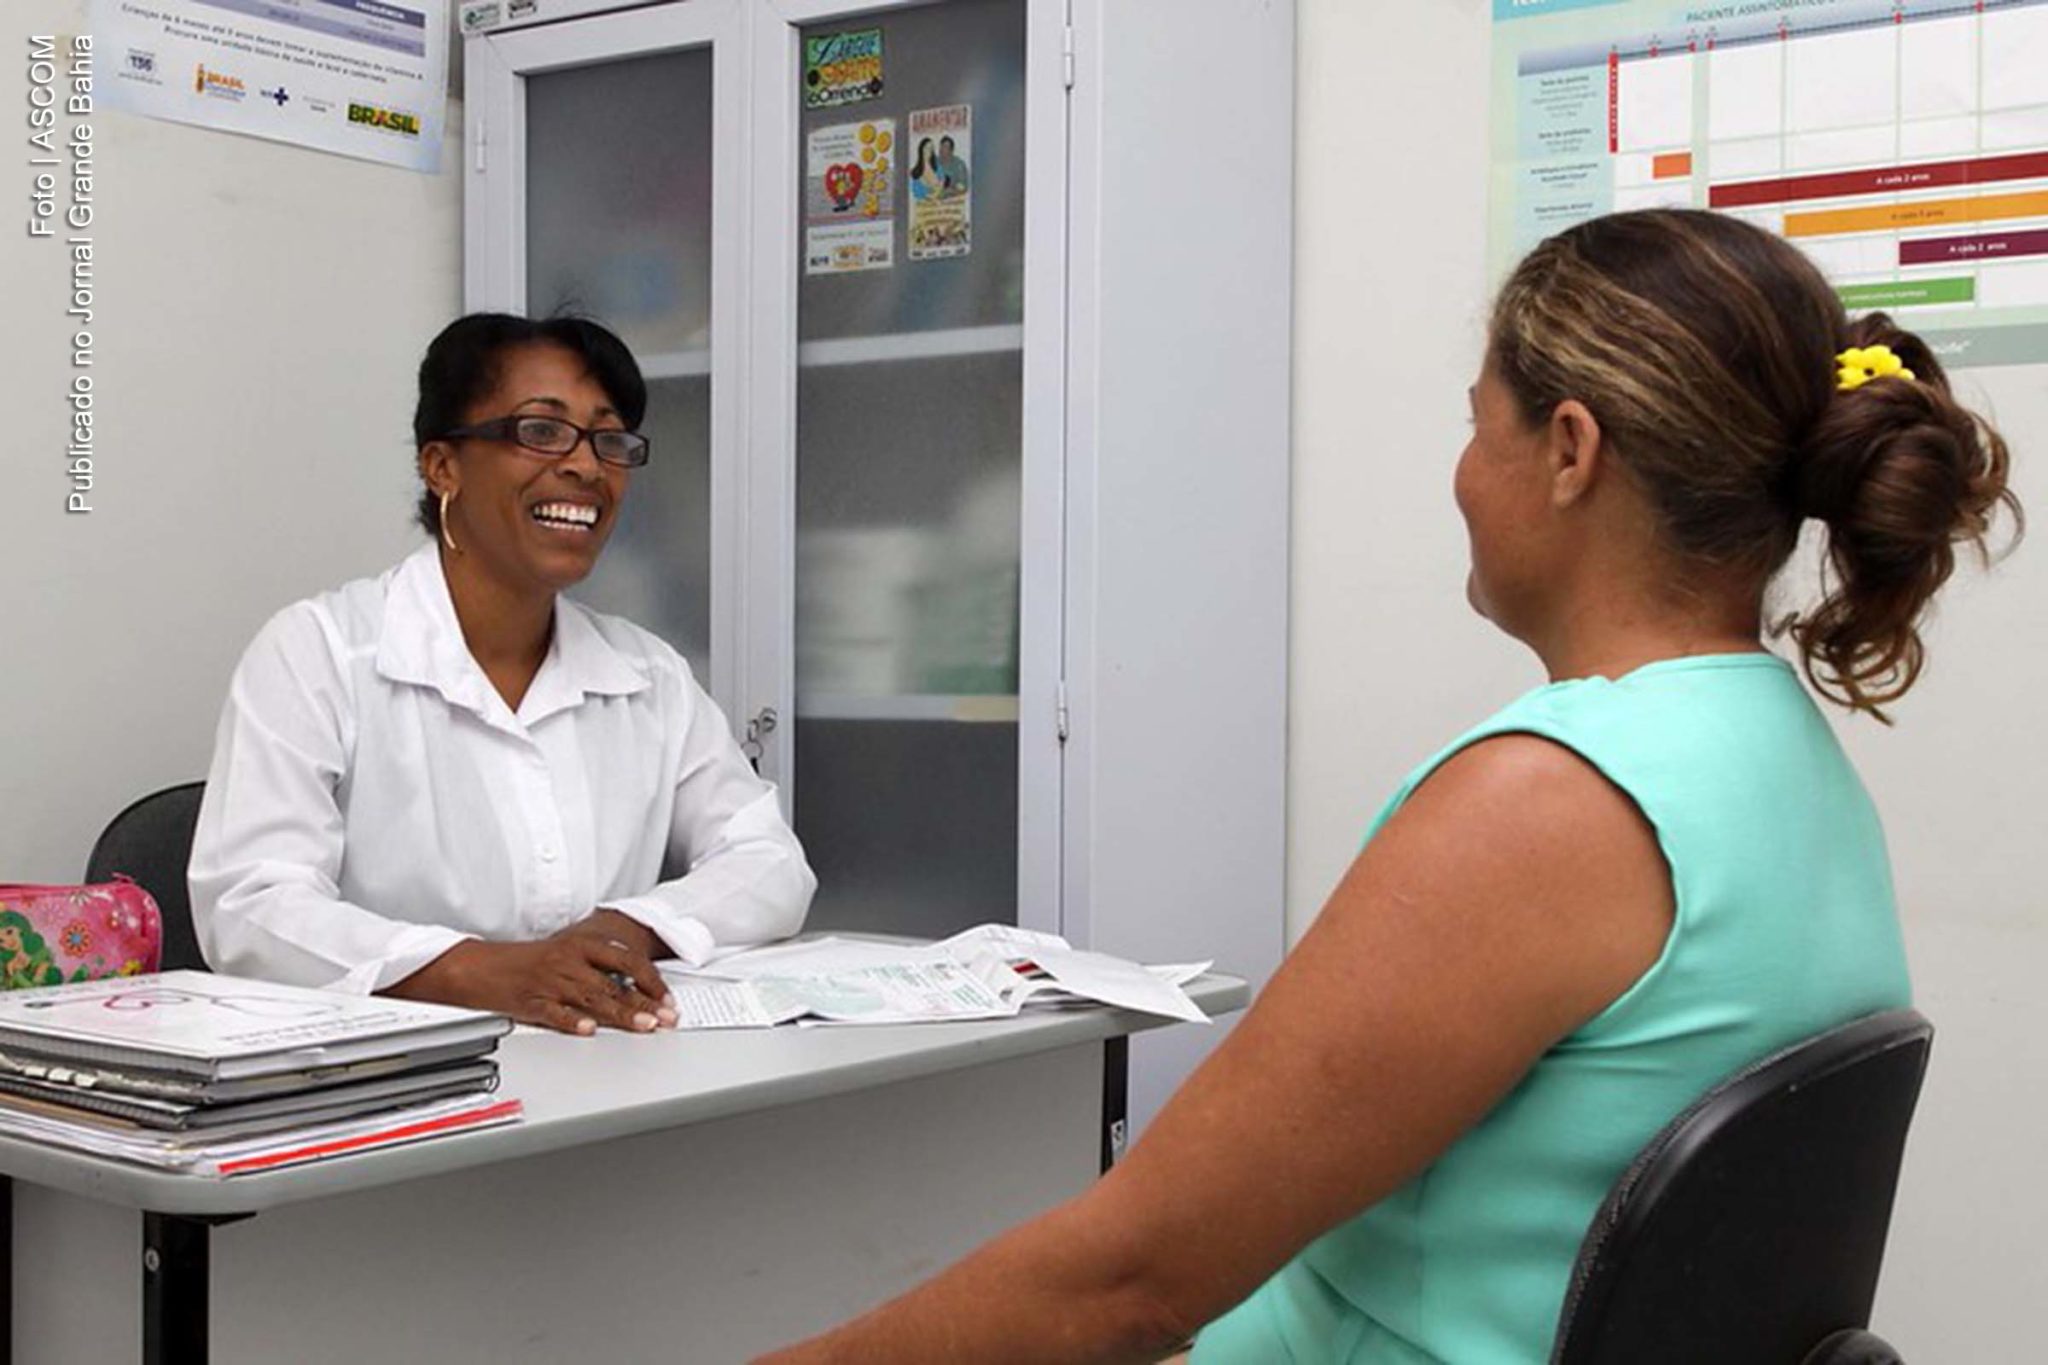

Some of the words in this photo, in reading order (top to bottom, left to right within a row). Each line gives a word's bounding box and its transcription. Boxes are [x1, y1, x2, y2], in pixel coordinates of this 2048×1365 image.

[182, 18, 210, 30] meses
[235, 31, 254, 41] anos
[255, 34, 282, 48] devem
[283, 42, 306, 54] tomar
[372, 62, 383, 72] de
[384, 65, 416, 79] vitamina
[281, 52, 291, 62] de
[348, 103, 419, 135] BRASIL
[1876, 176, 1883, 185] A
[1884, 174, 1902, 184] cada
[1904, 173, 1910, 182] 2
[1911, 173, 1930, 181] anos
[1950, 245, 1956, 253] A
[1958, 243, 1976, 252] cada
[1978, 242, 1984, 250] 2
[1987, 242, 2007, 250] anos
